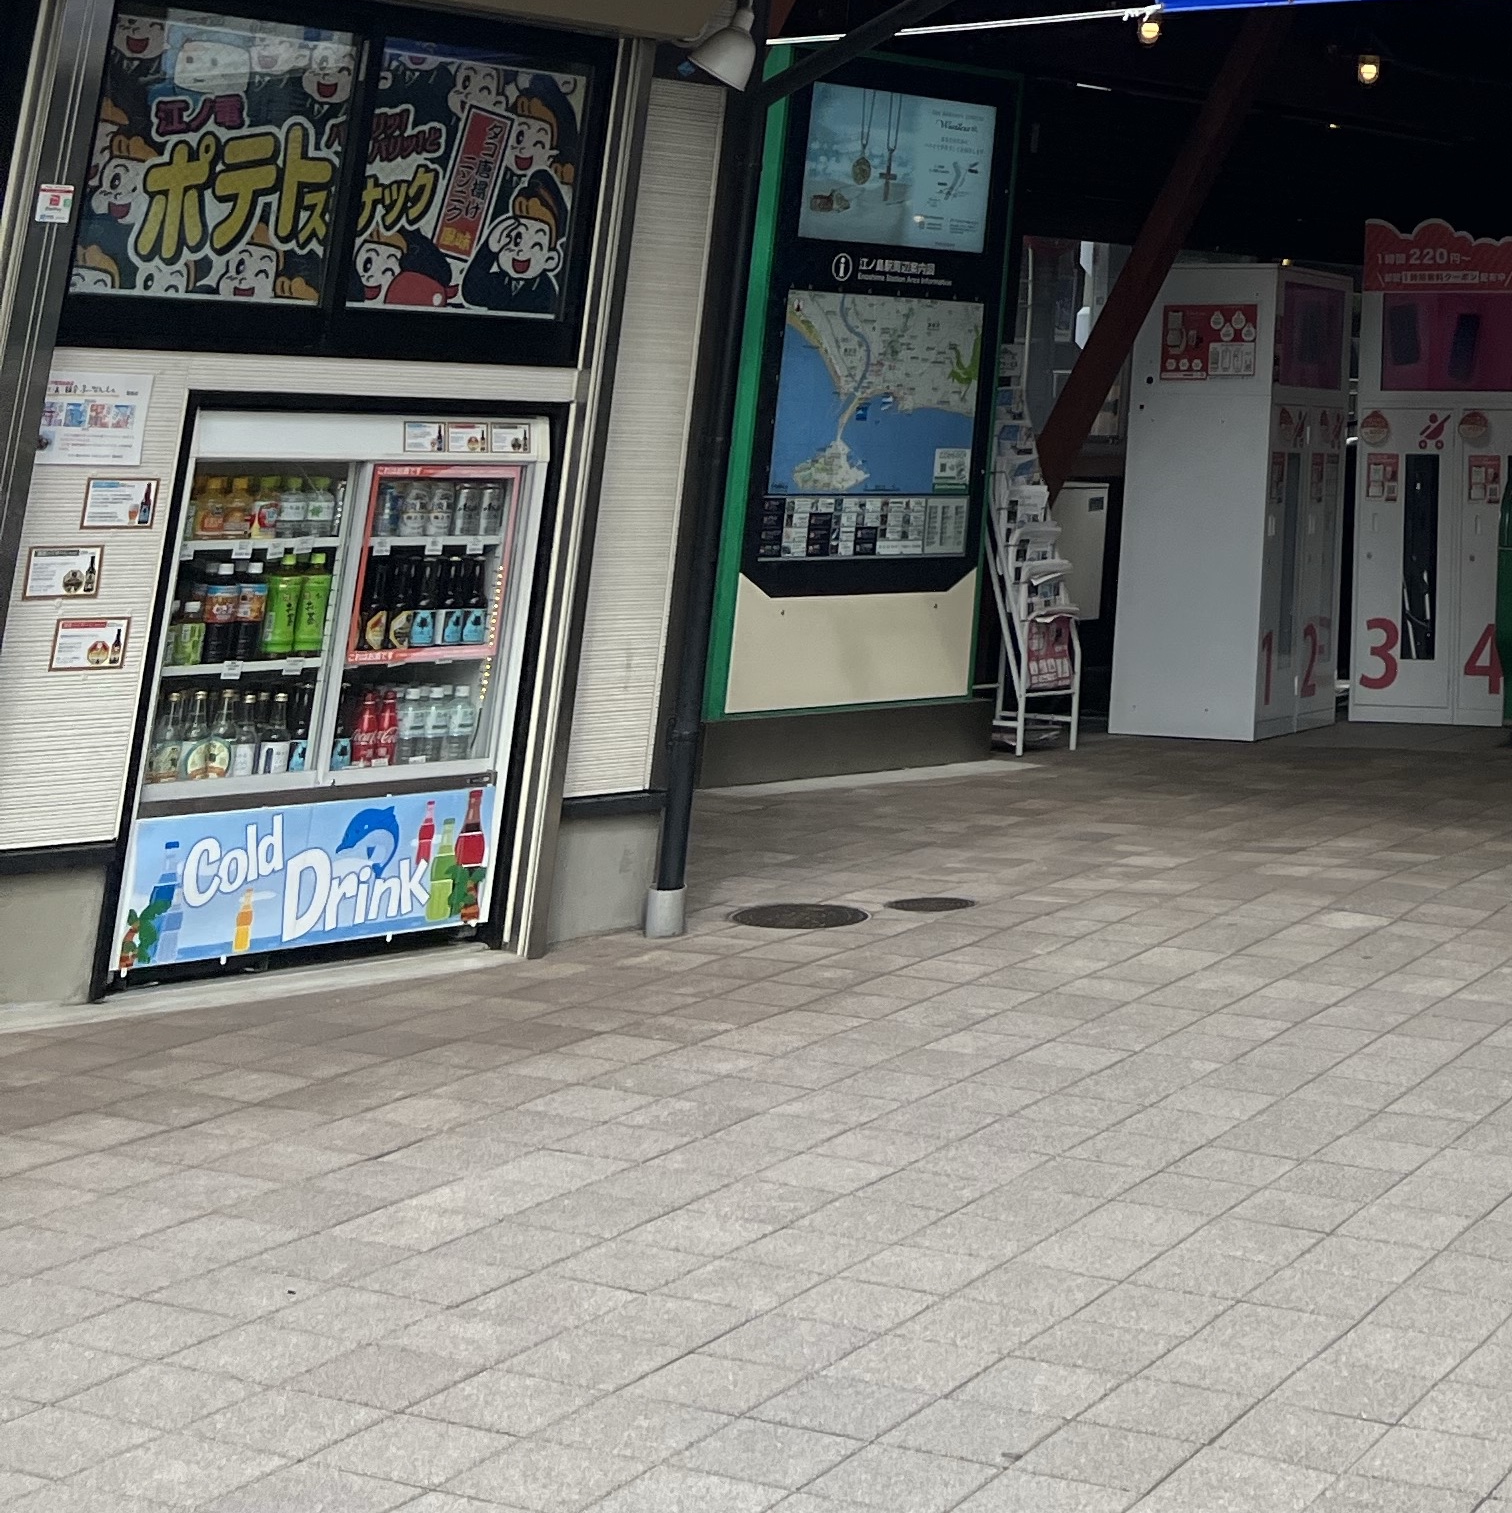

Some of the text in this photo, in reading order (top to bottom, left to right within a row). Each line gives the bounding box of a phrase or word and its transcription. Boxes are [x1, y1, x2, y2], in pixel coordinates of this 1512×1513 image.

[1359, 617, 1399, 690] 3
[1464, 623, 1504, 695] 4
[184, 814, 430, 943] Cold Drink
